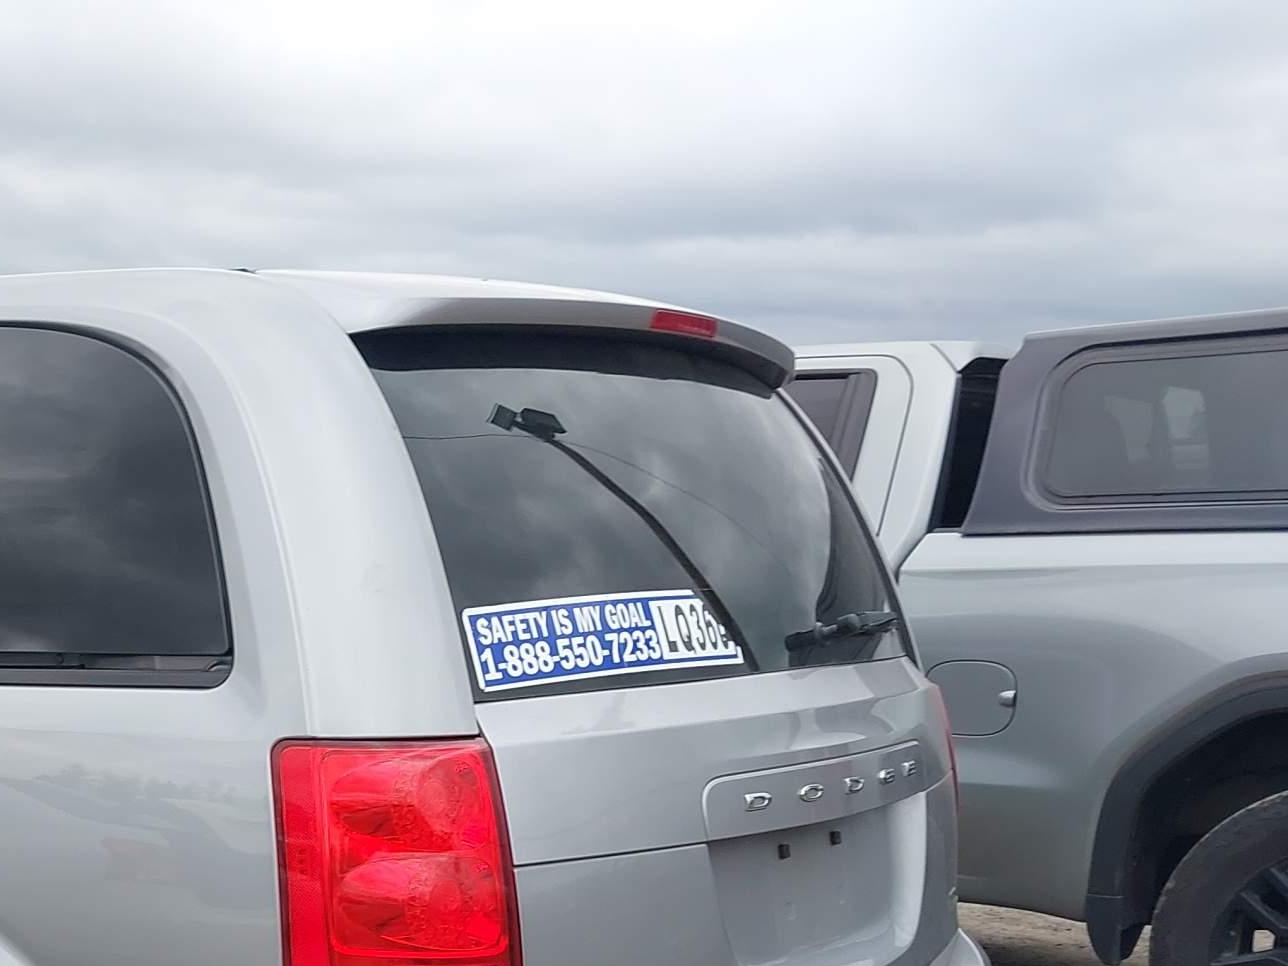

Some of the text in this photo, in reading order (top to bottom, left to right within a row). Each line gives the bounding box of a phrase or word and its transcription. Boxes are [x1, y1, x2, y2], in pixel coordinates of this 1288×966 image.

[476, 601, 651, 645] SAFETY IS MY GOAL
[480, 631, 661, 680] 1-888-550-7233
[743, 760, 917, 811] DODGE
